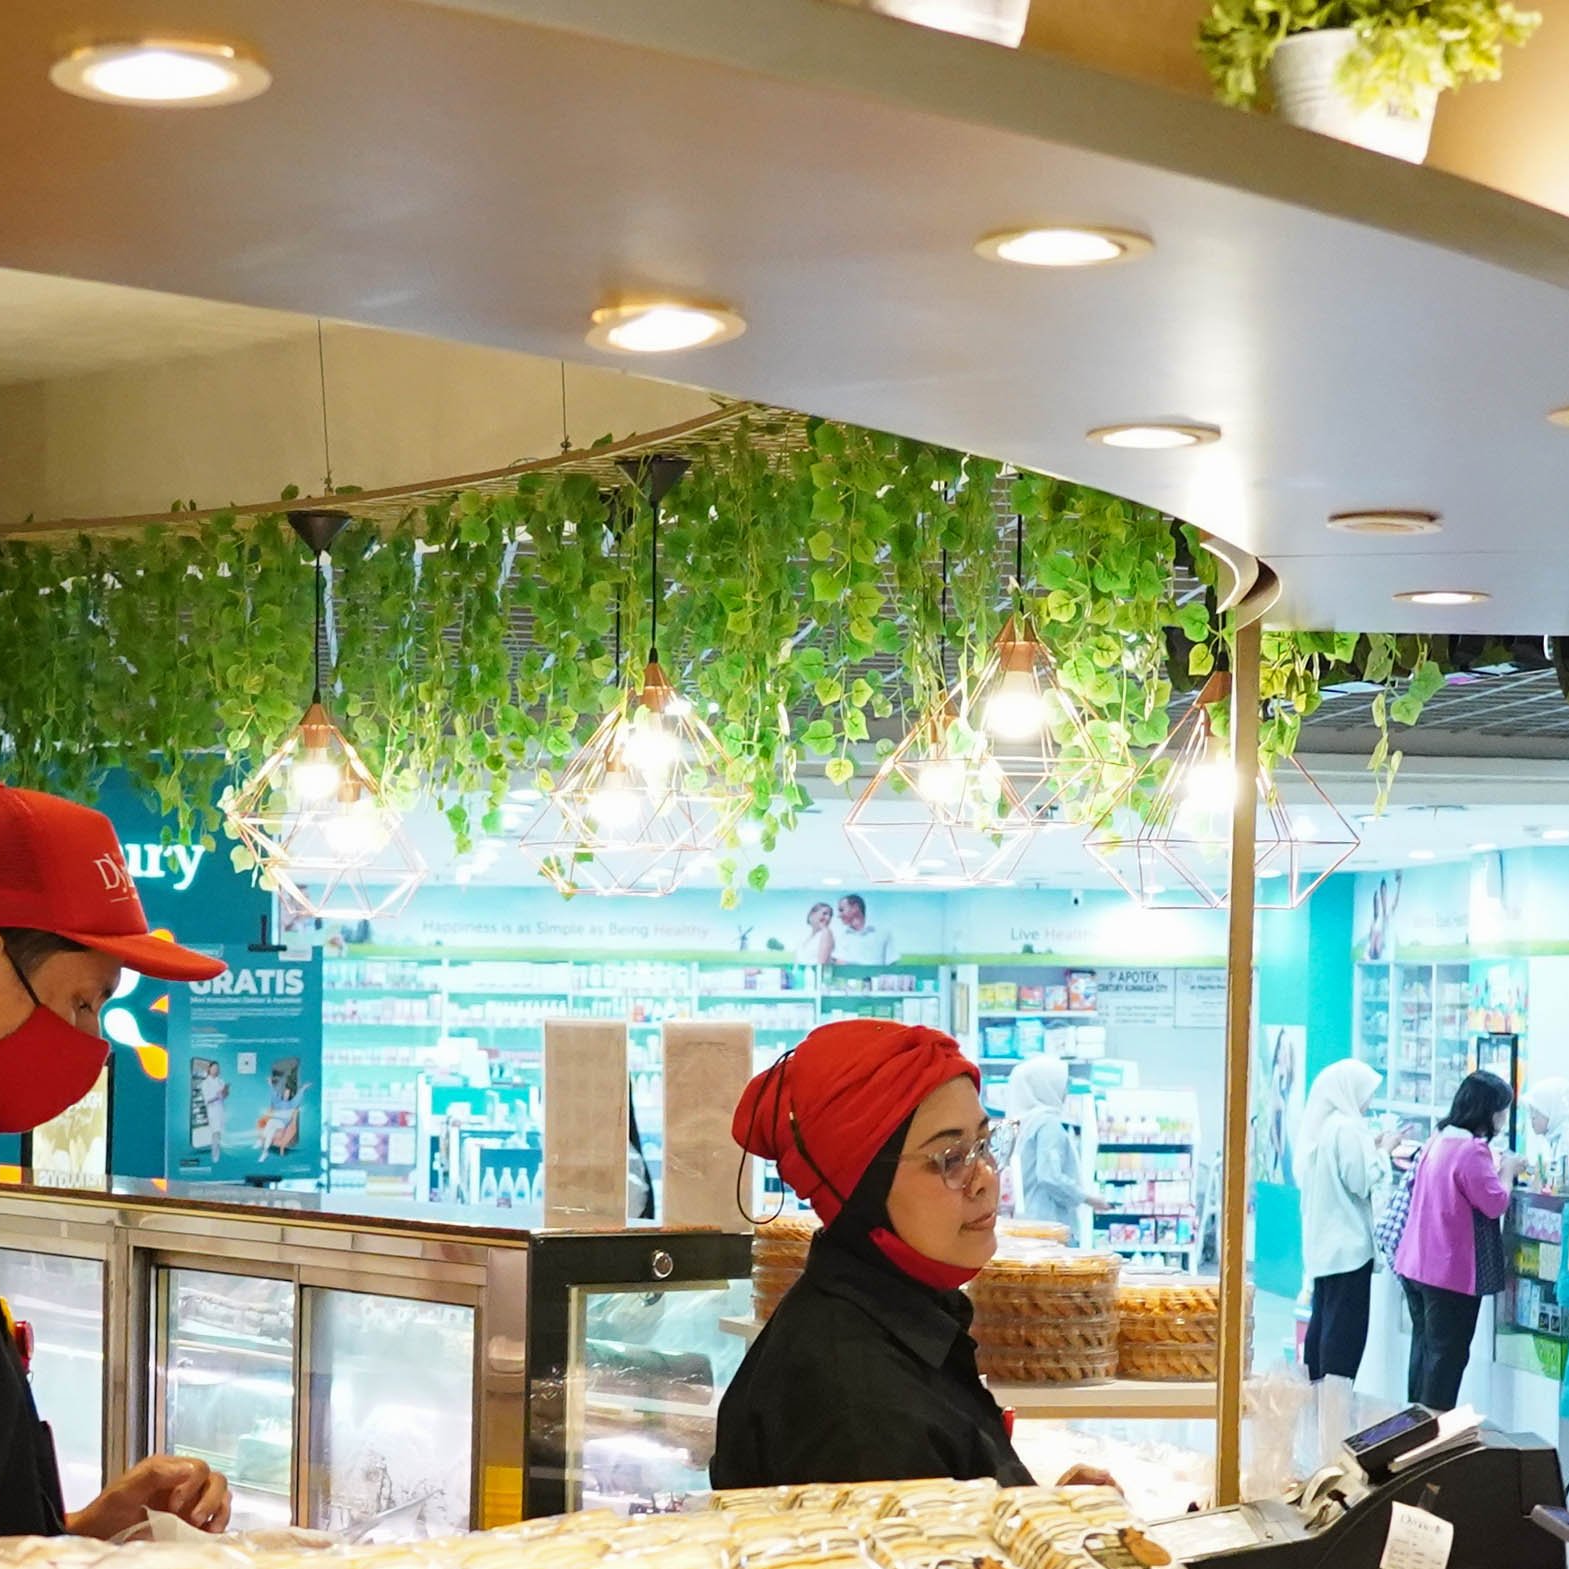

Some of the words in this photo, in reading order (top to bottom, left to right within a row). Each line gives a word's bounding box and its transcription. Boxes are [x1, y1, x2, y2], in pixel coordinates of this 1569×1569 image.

[120, 843, 205, 891] ury
[422, 920, 497, 936] Happiness
[502, 921, 512, 934] is
[517, 923, 531, 934] as
[536, 921, 585, 937] Simple
[589, 924, 604, 935] as
[609, 921, 649, 939] Being
[654, 922, 708, 939] Healthy
[1011, 928, 1039, 941] Live
[1117, 971, 1160, 984] APOTEK
